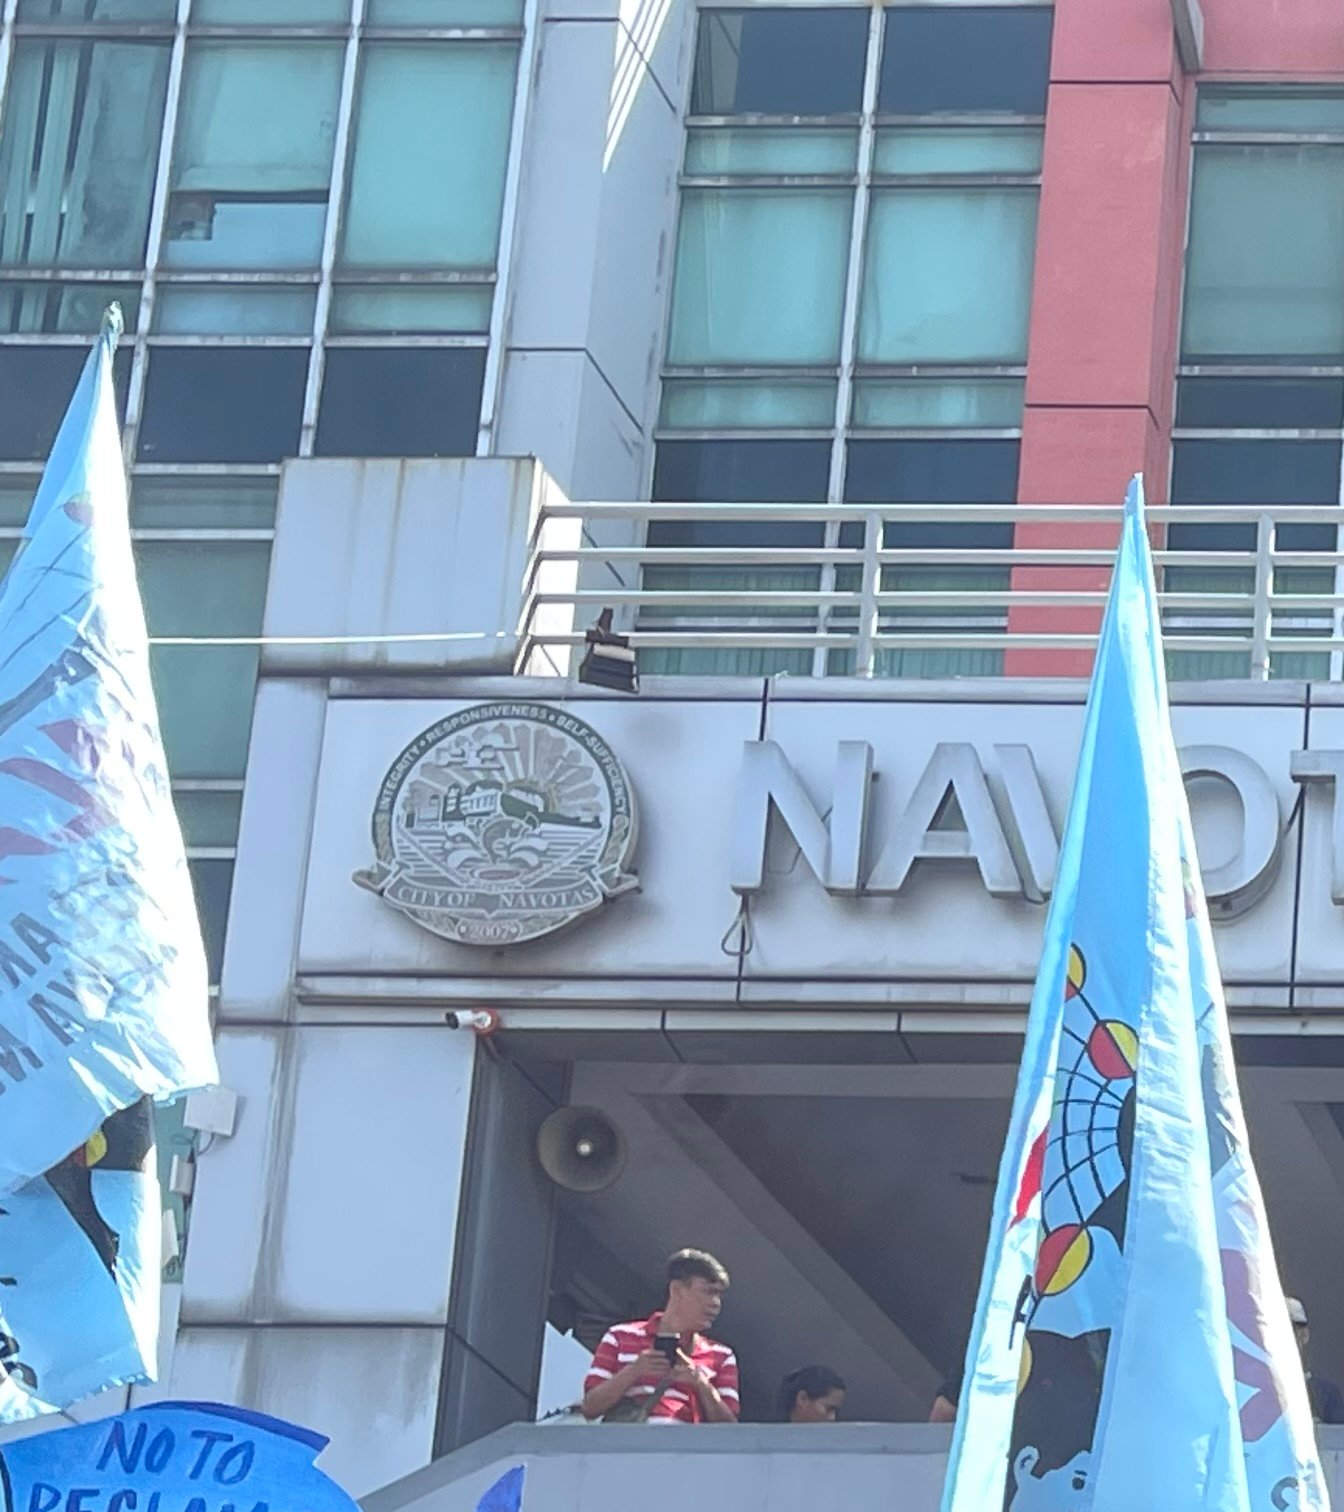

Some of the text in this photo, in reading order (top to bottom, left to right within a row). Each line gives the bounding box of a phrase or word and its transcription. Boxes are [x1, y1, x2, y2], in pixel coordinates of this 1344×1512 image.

[499, 886, 595, 910] NAVOTAS
[95, 1420, 256, 1485] NO TO
